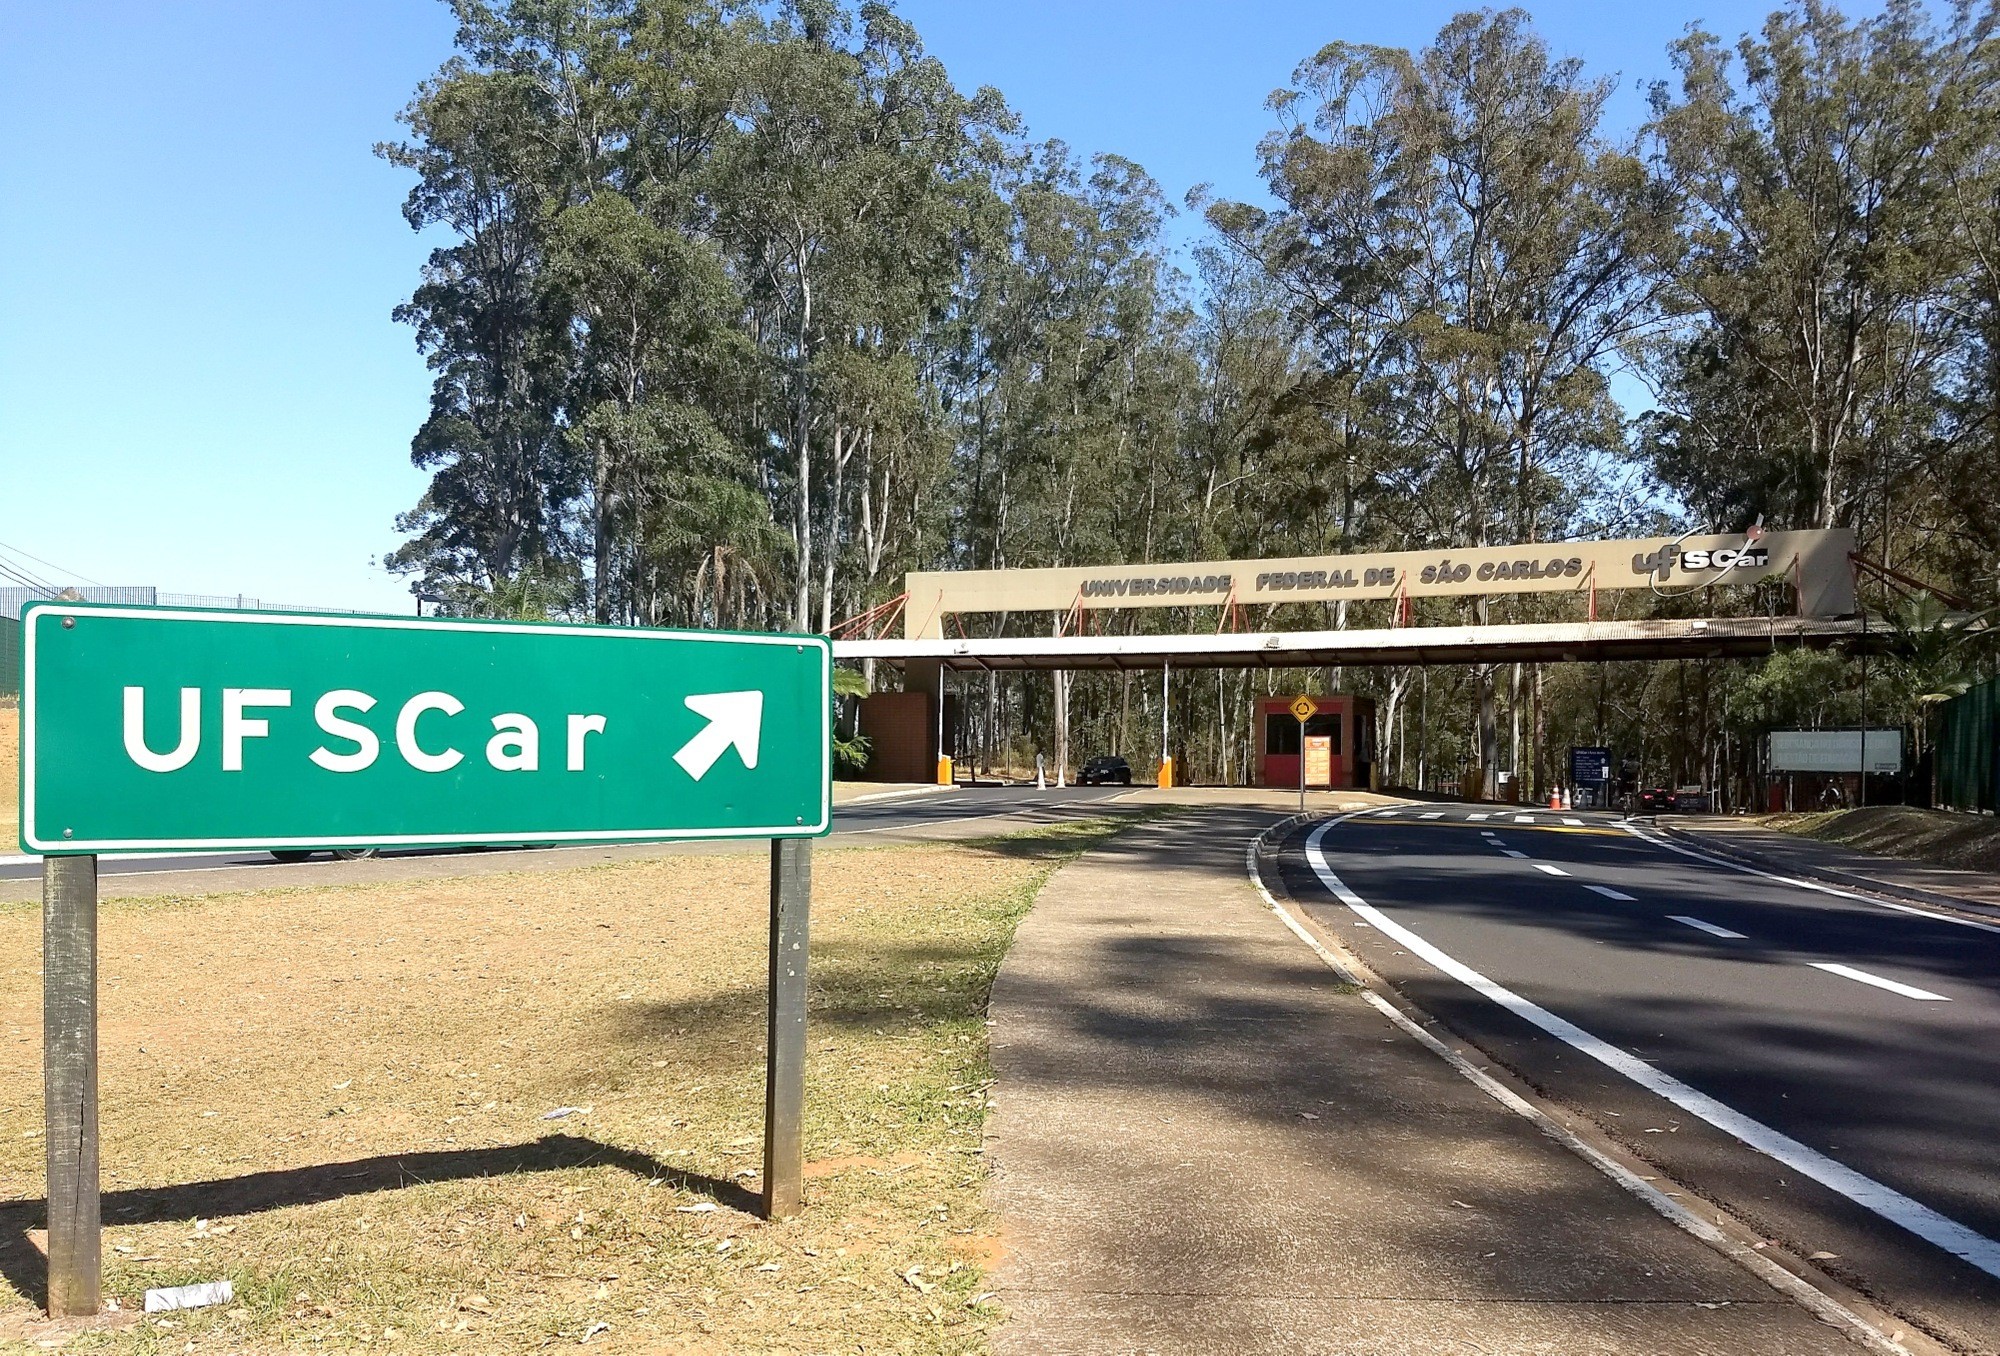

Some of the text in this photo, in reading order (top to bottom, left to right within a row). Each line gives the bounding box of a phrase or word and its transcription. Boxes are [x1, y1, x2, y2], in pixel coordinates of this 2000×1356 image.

[1081, 557, 1583, 598] UNIVERSIDADE FEDERAL DE SÃO CARLOS
[123, 686, 606, 772] UFSCar
